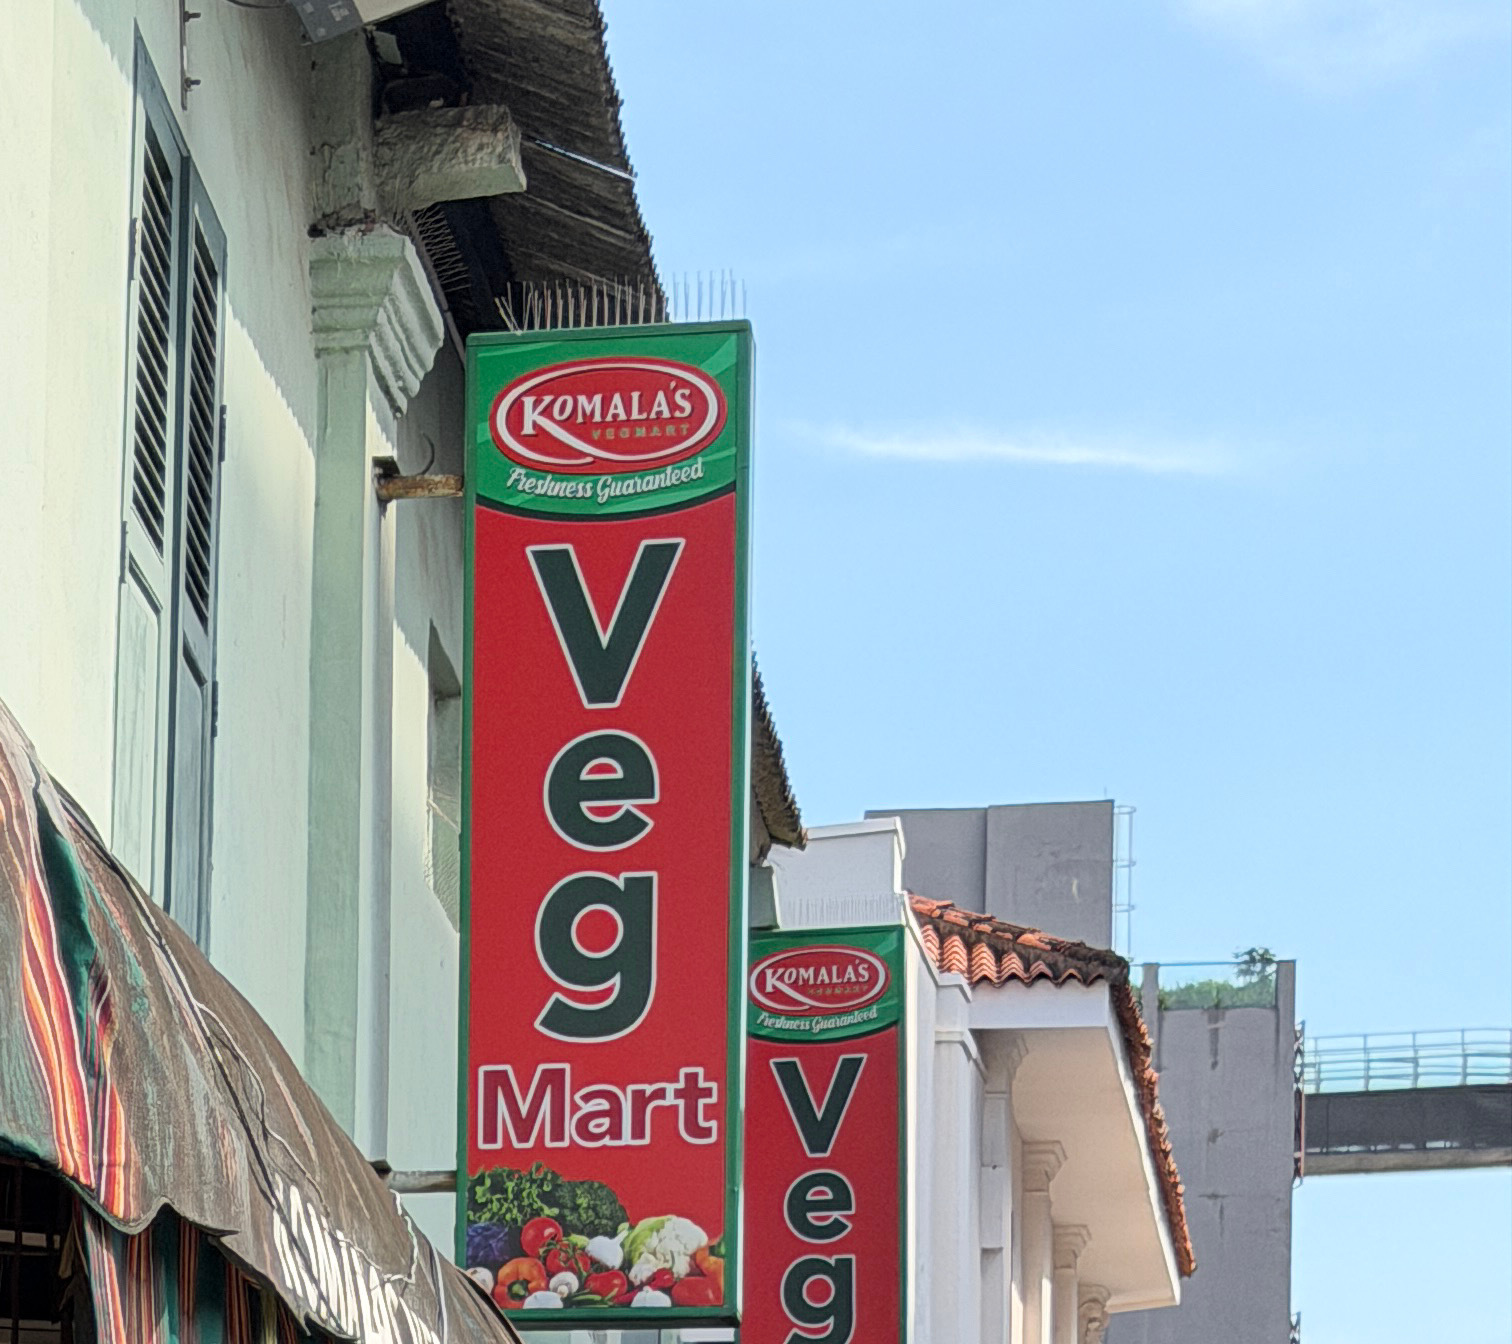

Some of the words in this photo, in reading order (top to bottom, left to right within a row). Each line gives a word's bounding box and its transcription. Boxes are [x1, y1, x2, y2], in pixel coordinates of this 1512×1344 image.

[519, 380, 693, 437] KOMALA'S
[506, 466, 593, 498] Freshness
[596, 456, 705, 504] Guaranteed
[525, 536, 688, 1045] Veg
[764, 957, 871, 994] KOMALA'S
[756, 1010, 810, 1030] Freshness
[811, 1005, 878, 1034] Guaranteed
[476, 1062, 719, 1151] Mart
